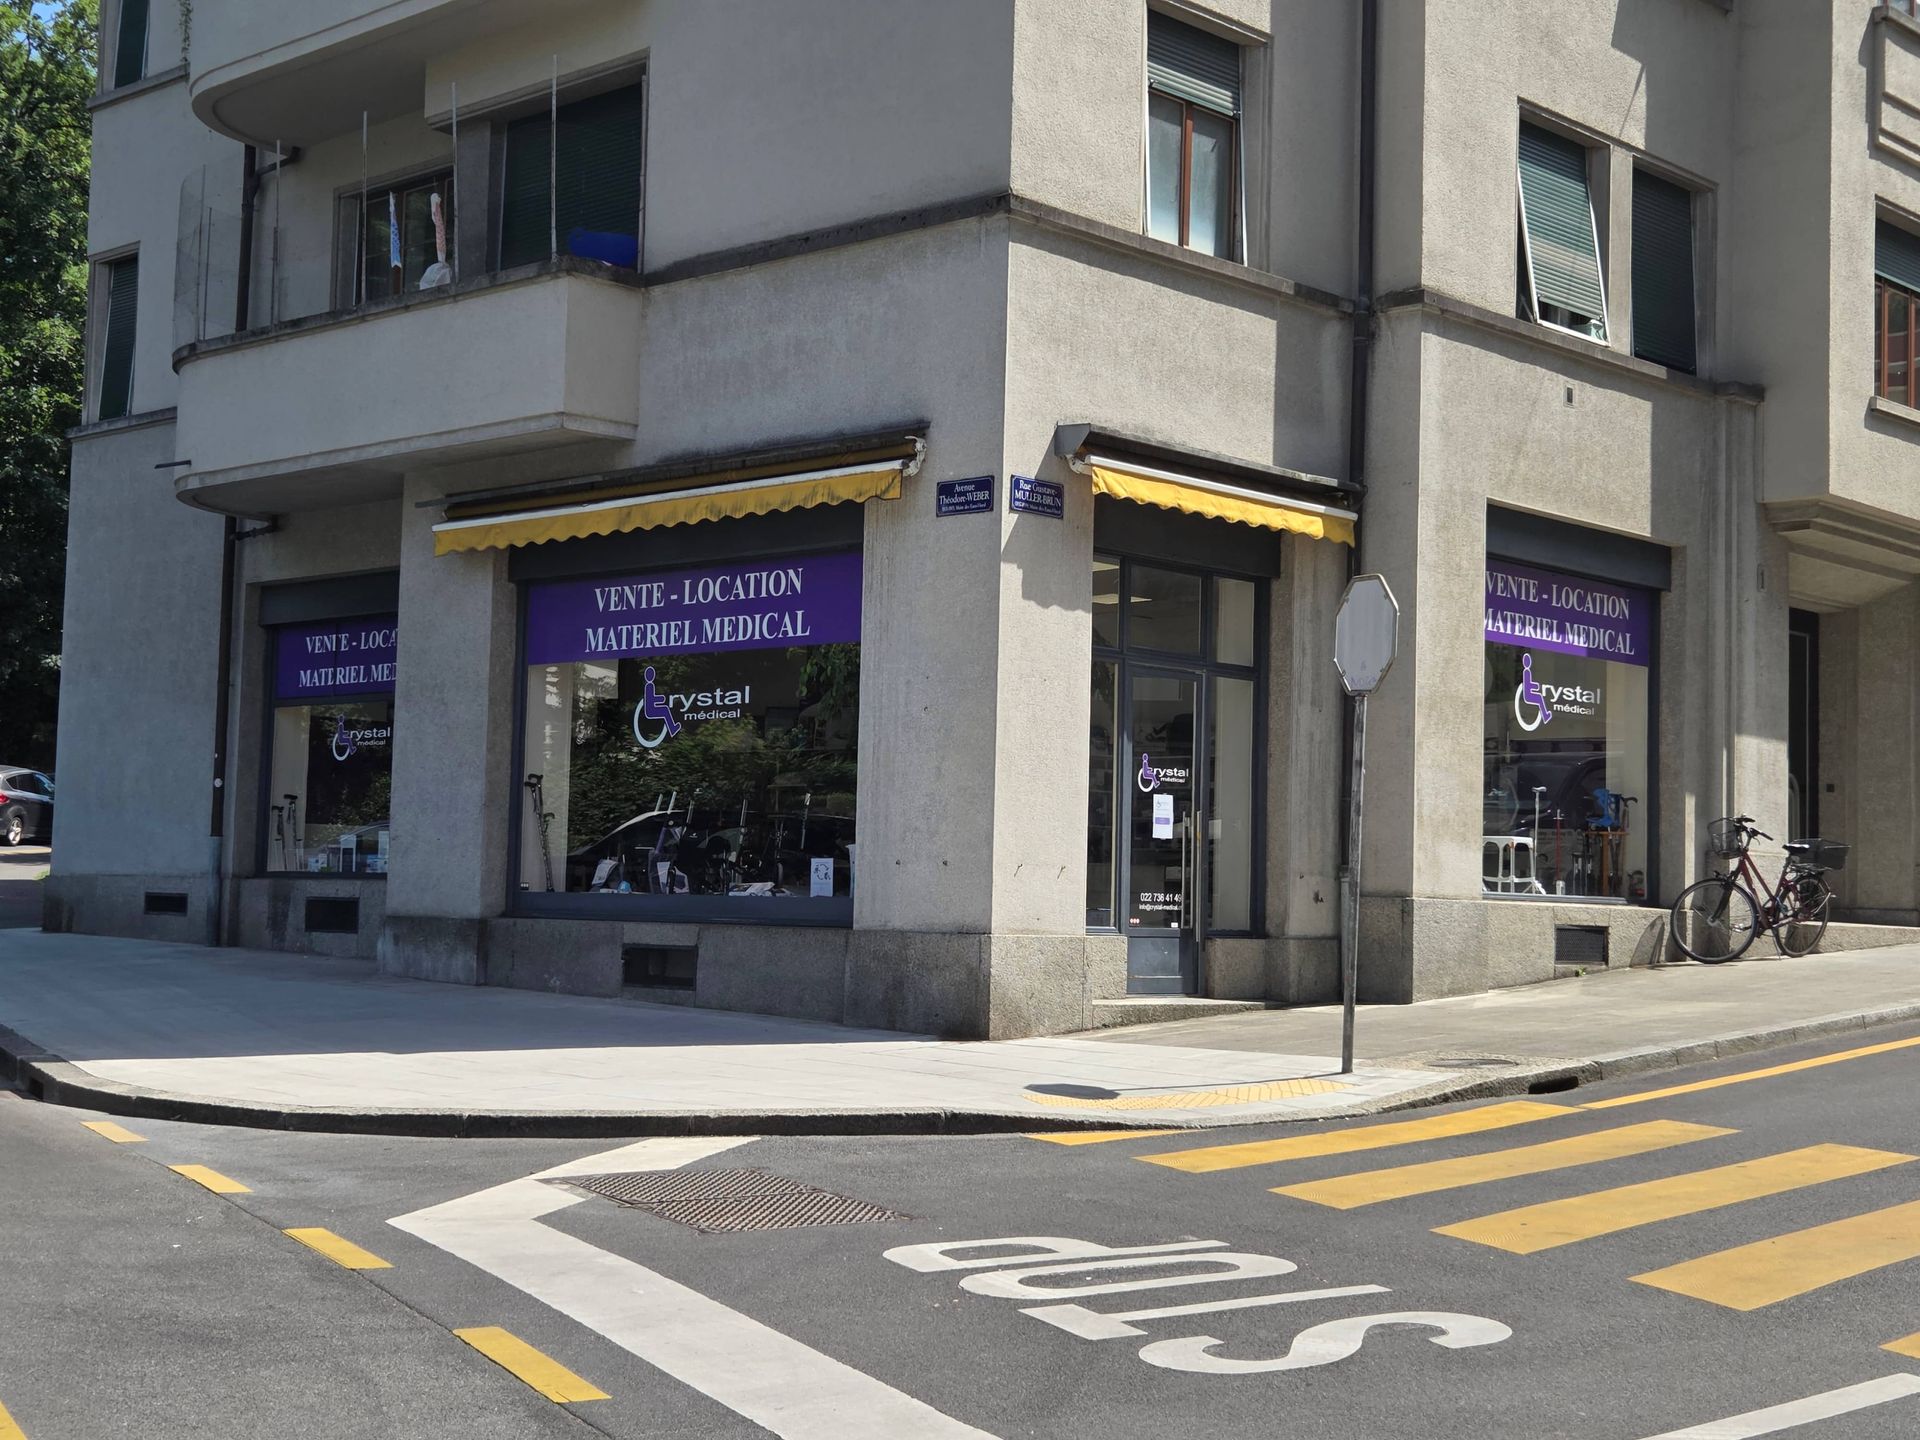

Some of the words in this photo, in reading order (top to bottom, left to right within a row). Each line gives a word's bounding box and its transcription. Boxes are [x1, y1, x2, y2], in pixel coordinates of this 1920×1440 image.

[953, 484, 976, 493] Avenue
[1019, 480, 1031, 491] Rue
[595, 582, 665, 612] VENTE
[683, 568, 804, 605] LOCATION
[1485, 571, 1539, 603] VENTE
[1552, 584, 1630, 620] LOCATION
[585, 621, 697, 653] MATERIEL
[701, 610, 811, 644] MEDICAL
[1565, 622, 1635, 655] MEDICAL
[684, 708, 740, 720] médical
[1553, 703, 1595, 715] médical
[1140, 892, 1152, 902] 022
[1165, 893, 1173, 902] 41
[882, 1236, 1513, 1374] STOP
